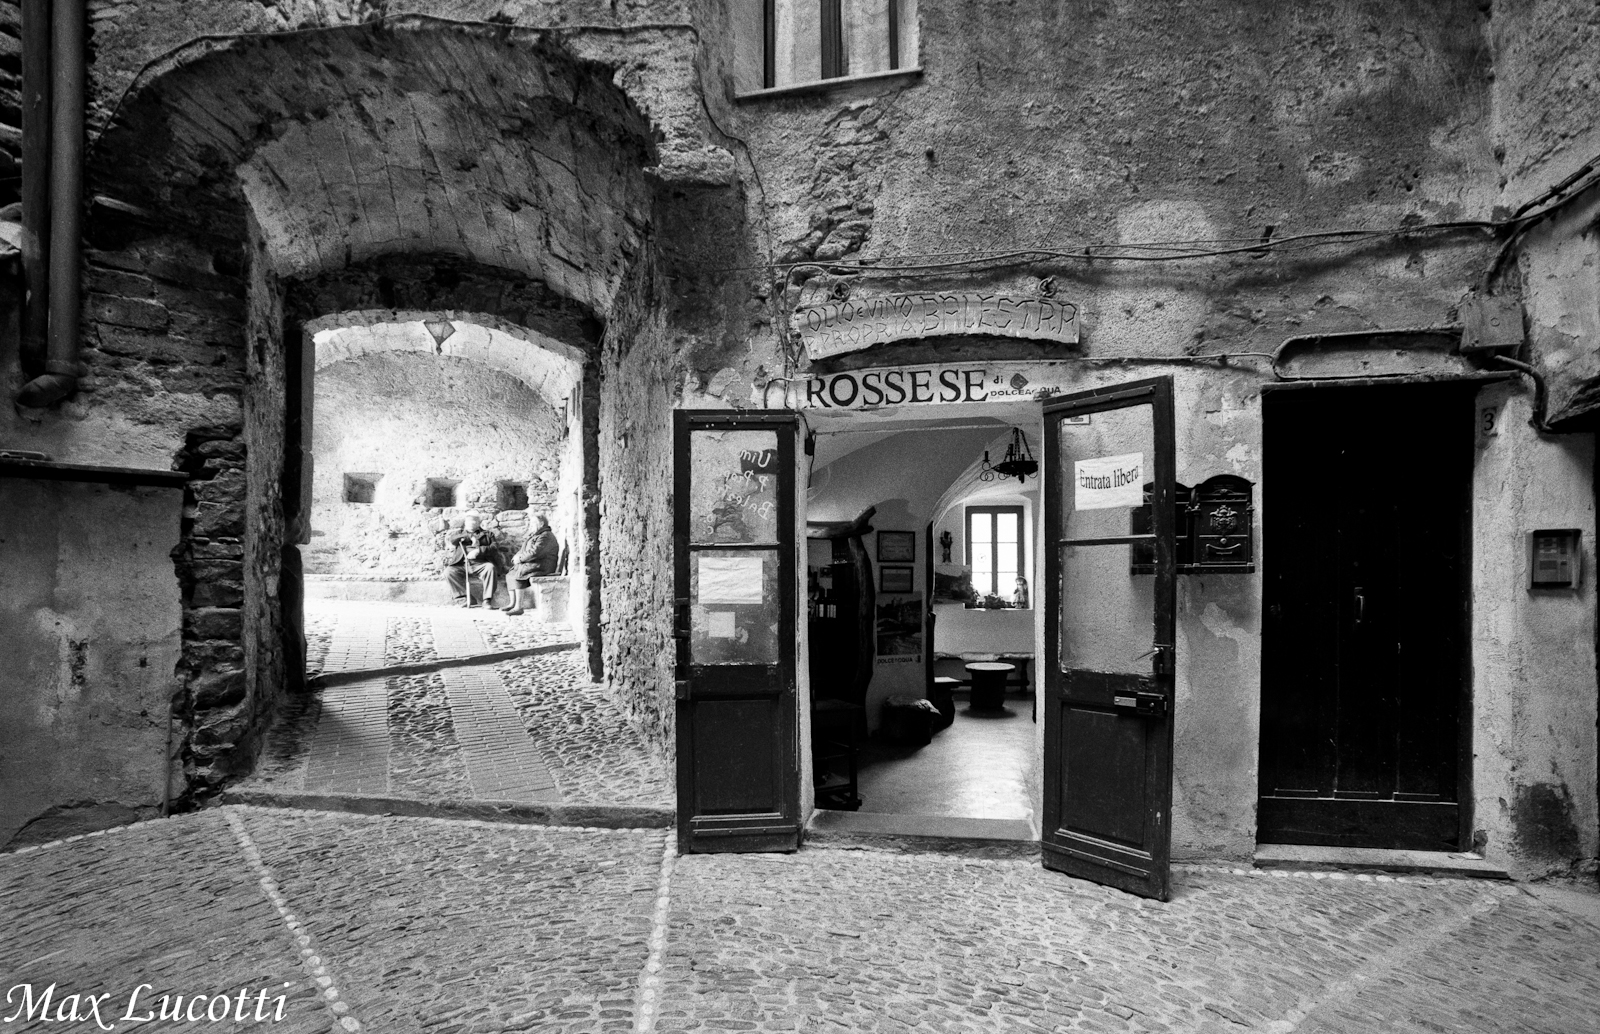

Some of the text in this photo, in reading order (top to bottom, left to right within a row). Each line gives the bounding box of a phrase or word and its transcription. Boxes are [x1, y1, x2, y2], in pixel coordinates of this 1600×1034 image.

[807, 302, 854, 332] OLIO
[863, 296, 914, 319] VINO
[920, 294, 1077, 335] BALESTRA
[806, 369, 1004, 408] ROSSESE di
[1484, 412, 1494, 431] 3
[1080, 465, 1139, 490] Entrata libera
